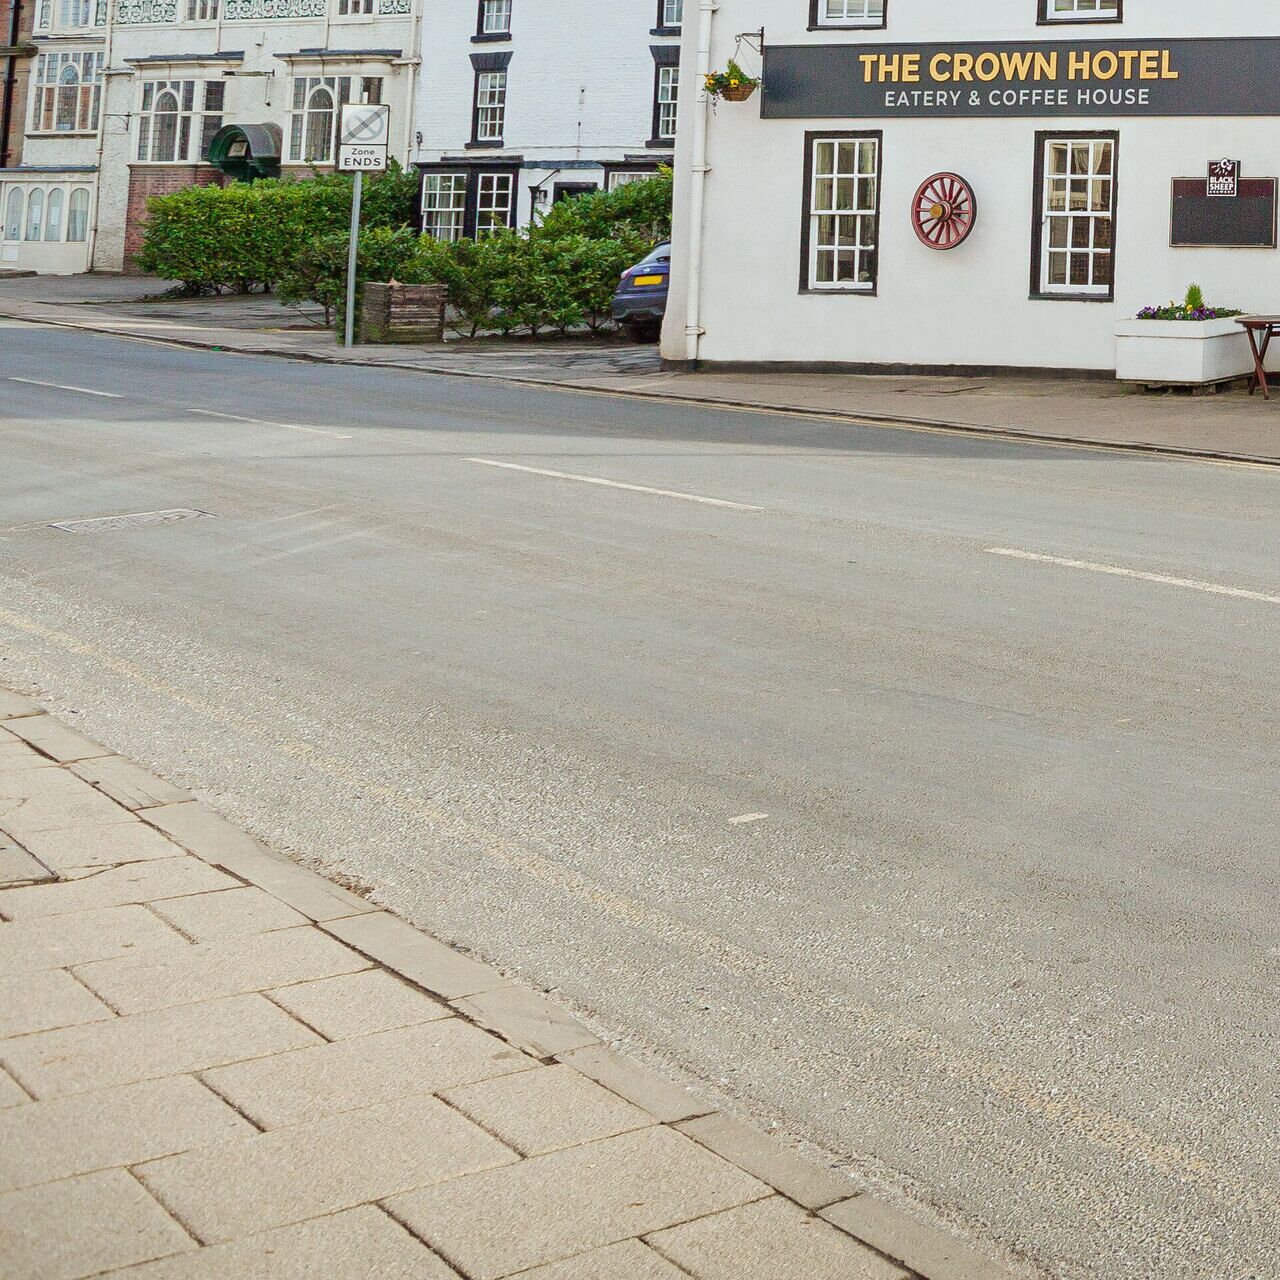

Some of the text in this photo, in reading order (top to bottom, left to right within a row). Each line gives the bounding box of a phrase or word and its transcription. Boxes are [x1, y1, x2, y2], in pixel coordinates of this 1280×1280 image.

[859, 50, 1179, 83] THE CROWN HOTEL
[884, 88, 1150, 107] EATERY & COFFEE HOUSE
[351, 147, 375, 155] Zone
[344, 157, 381, 166] ENDS
[1210, 176, 1234, 184] BLACK
